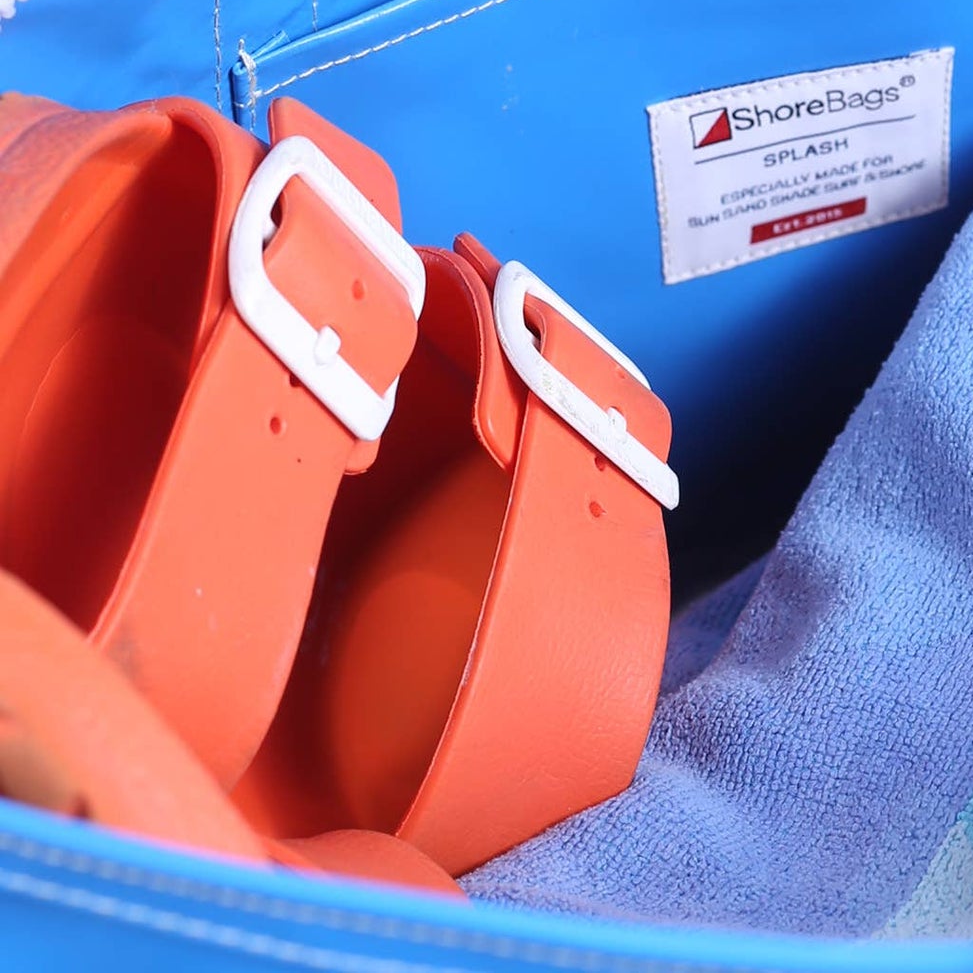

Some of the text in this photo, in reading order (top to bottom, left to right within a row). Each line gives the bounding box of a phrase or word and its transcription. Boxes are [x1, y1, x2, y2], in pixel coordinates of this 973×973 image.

[763, 138, 850, 168] SPLASH
[687, 213, 720, 228] SUN
[723, 200, 767, 219] SAND
[770, 187, 821, 207] SHADE
[823, 175, 861, 194] SURF
[877, 158, 927, 179] SHORE
[720, 155, 893, 205] ESPECIALLY MADE FOR
